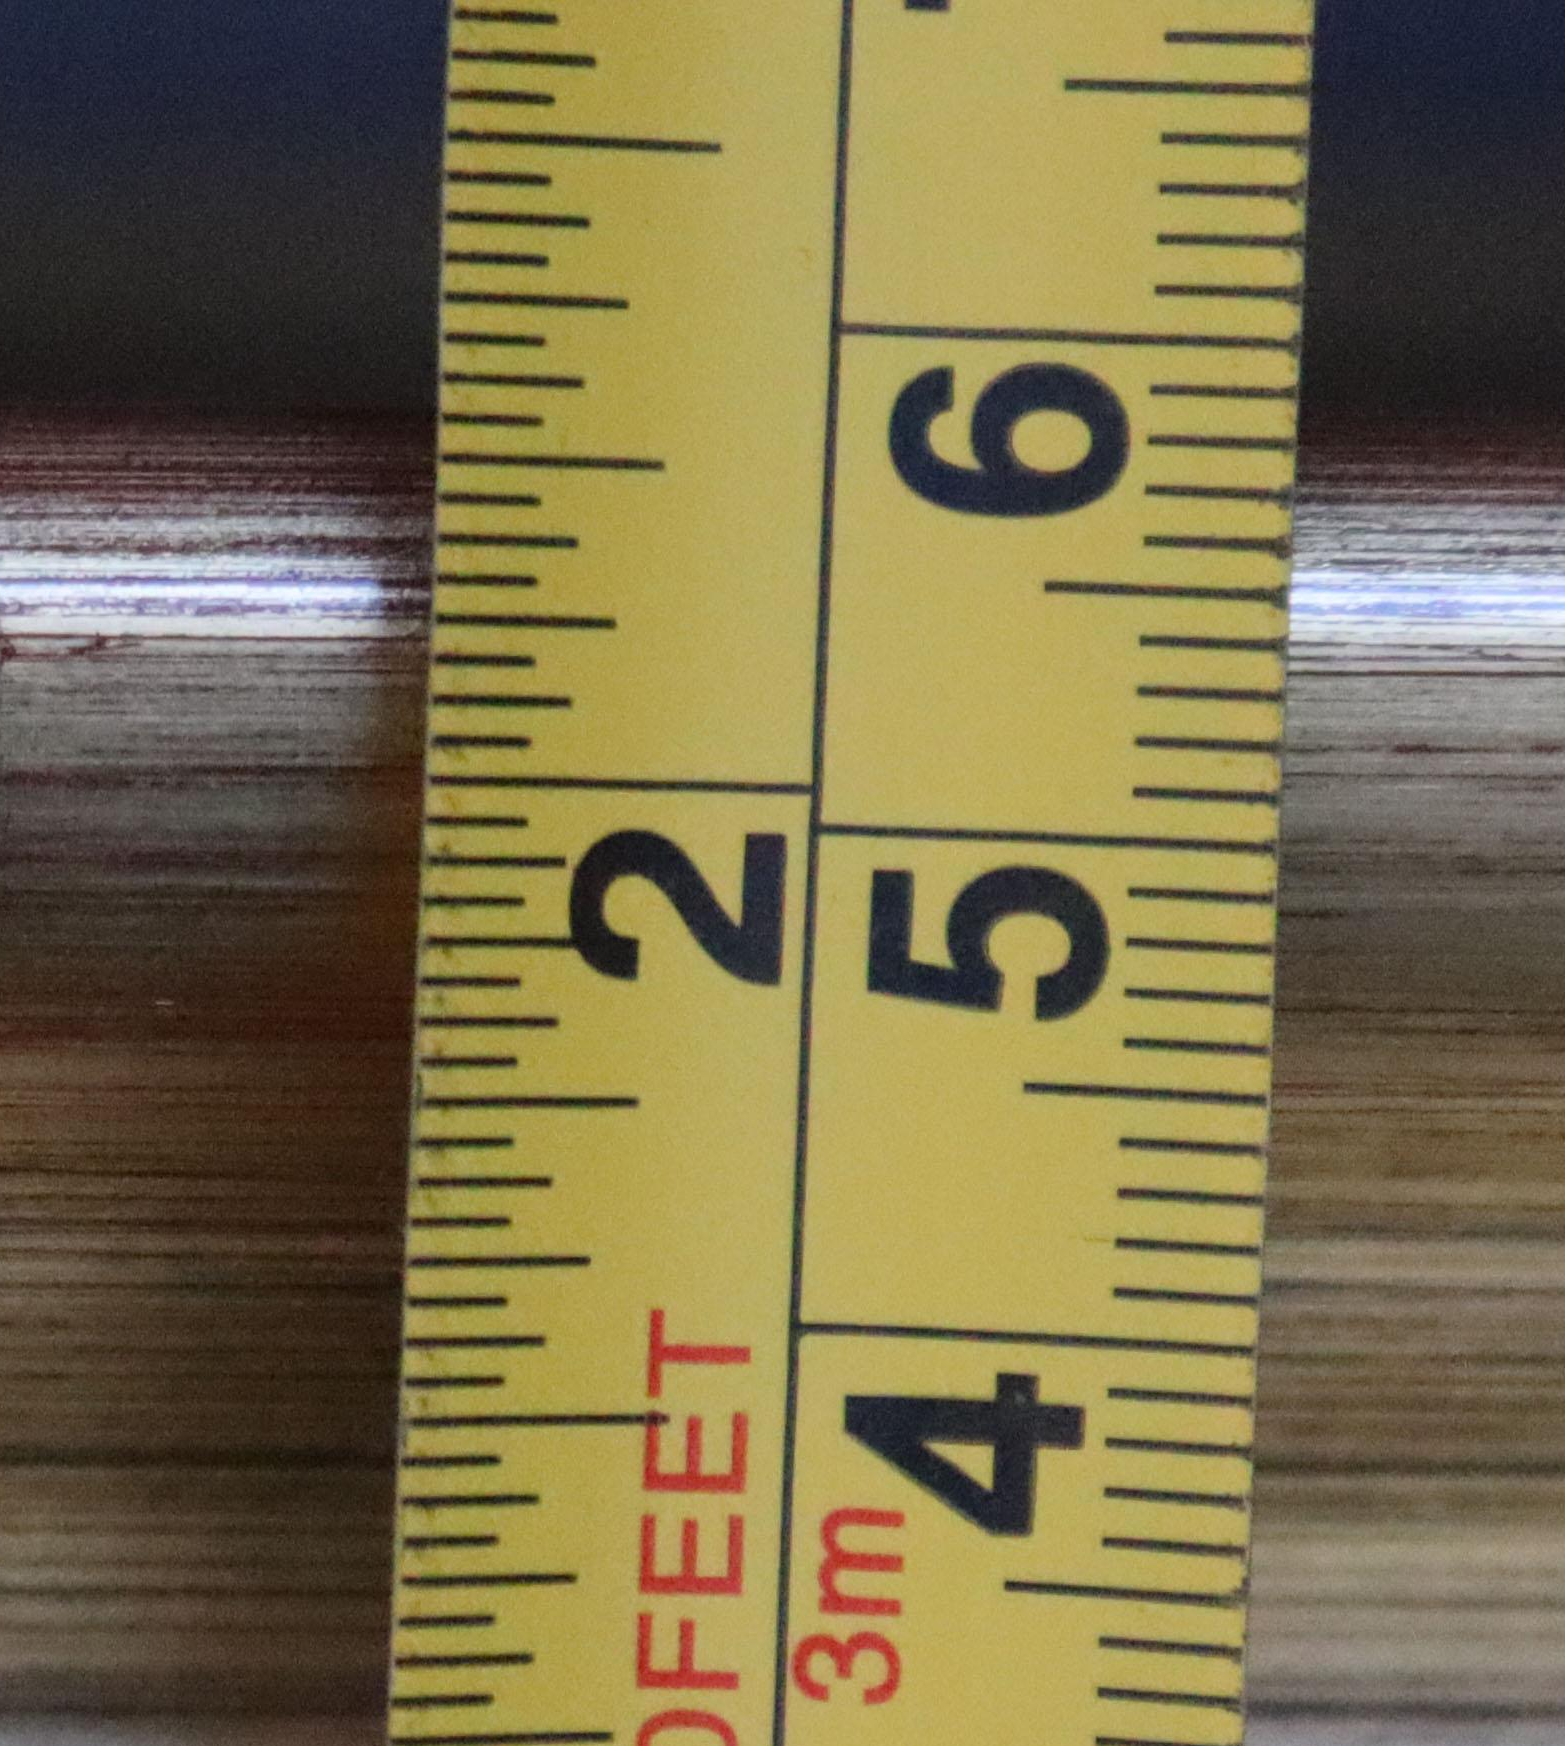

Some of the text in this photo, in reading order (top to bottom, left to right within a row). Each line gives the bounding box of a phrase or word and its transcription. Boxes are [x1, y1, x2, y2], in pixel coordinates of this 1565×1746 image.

[888, 362, 1130, 519] 6
[569, 829, 787, 986] 2
[867, 865, 1111, 1022] 5
[843, 1372, 1085, 1537] 4
[791, 1507, 906, 1705] 3m
